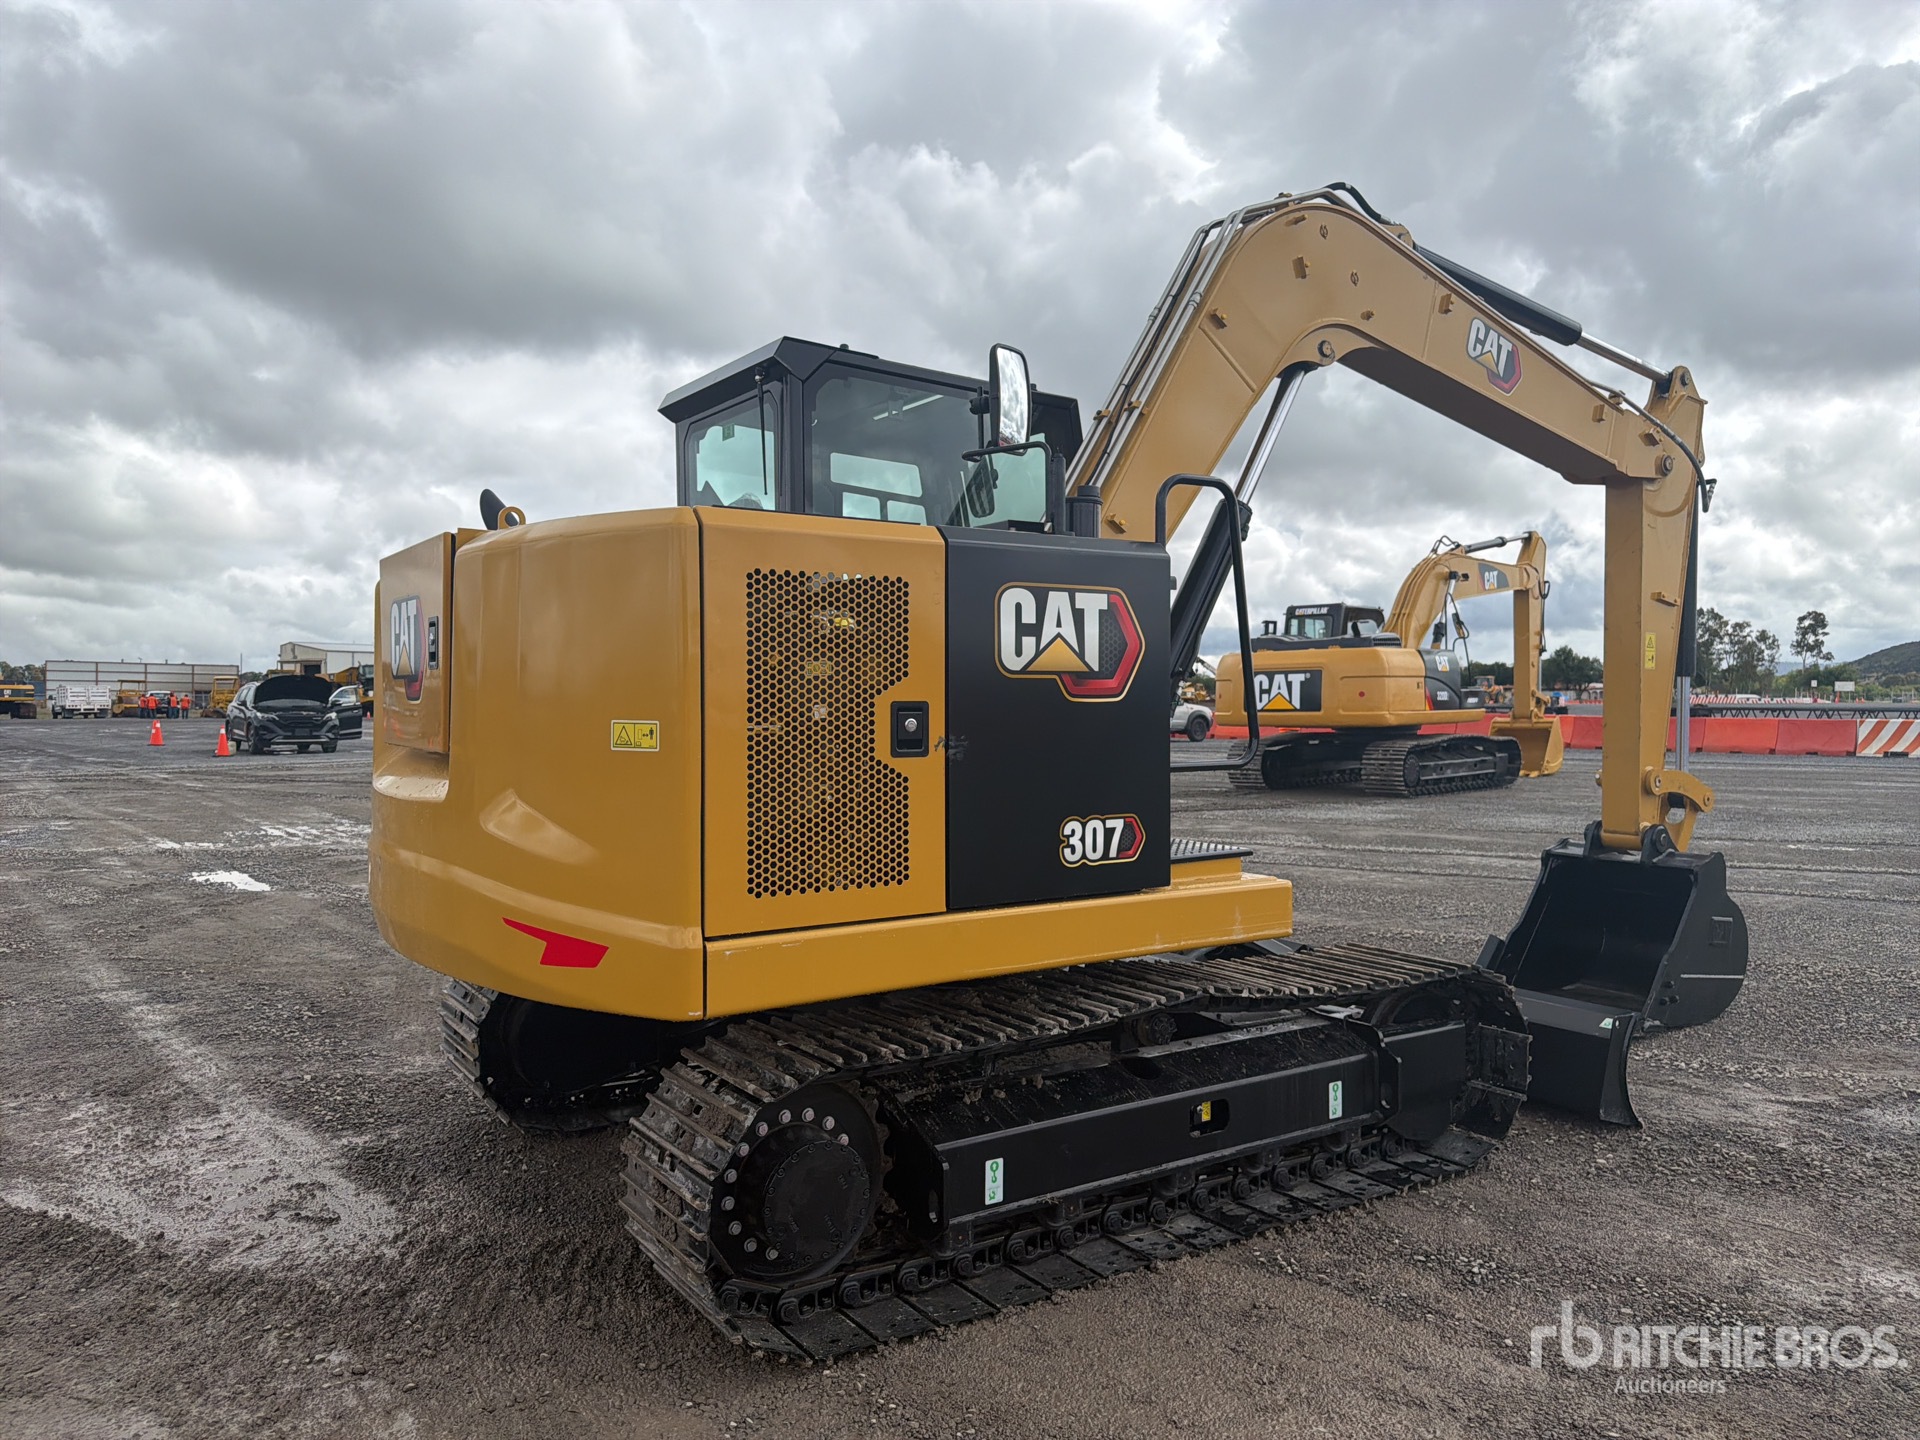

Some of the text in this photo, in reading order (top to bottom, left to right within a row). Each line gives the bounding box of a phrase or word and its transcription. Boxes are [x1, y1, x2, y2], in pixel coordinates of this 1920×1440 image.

[1467, 318, 1513, 378] CAT
[1484, 571, 1498, 590] CAT
[1000, 587, 1108, 671] CAT
[1295, 606, 1330, 616] CATERPILLAR
[391, 599, 417, 676] CAT
[1435, 655, 1450, 672] CAT
[1253, 673, 1306, 711] CAT
[1063, 818, 1125, 862] 307
